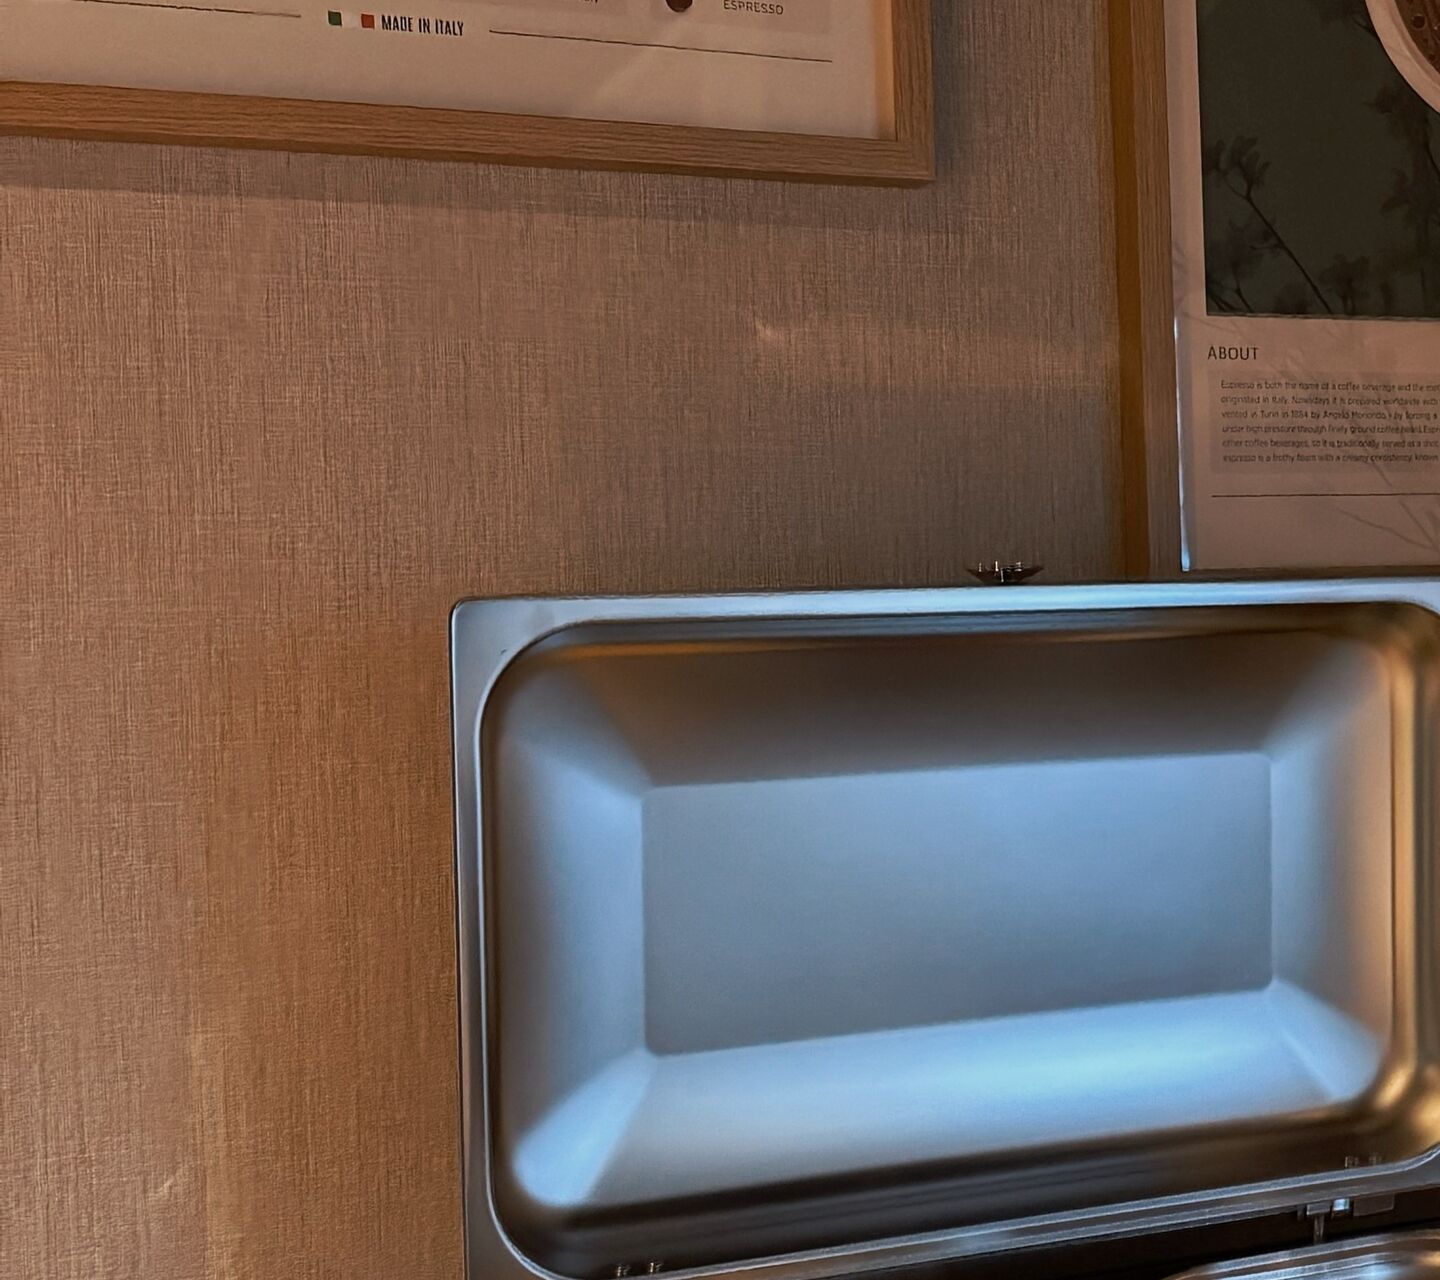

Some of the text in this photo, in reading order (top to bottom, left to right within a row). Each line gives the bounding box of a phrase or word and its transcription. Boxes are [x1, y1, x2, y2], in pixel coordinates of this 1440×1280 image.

[723, 0, 784, 15] ESPRESSO
[381, 13, 464, 36] MADE IN ITALY
[1208, 346, 1258, 361] ABOUT
